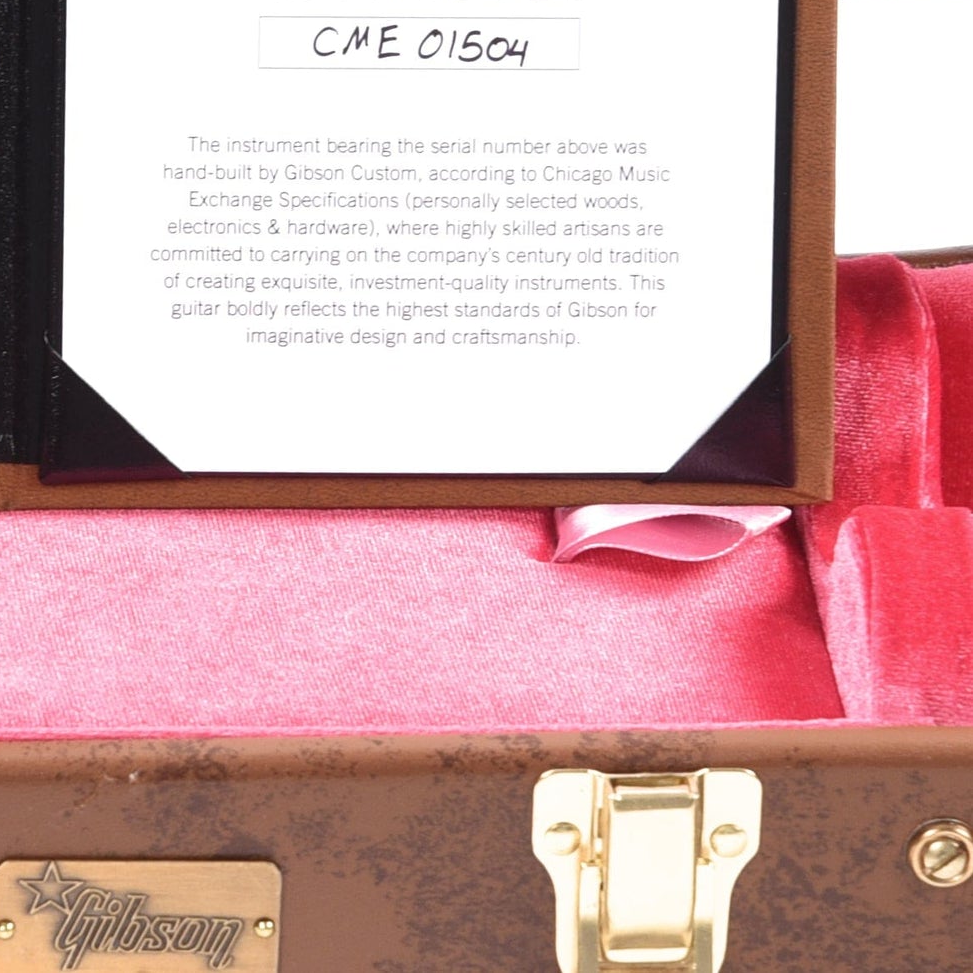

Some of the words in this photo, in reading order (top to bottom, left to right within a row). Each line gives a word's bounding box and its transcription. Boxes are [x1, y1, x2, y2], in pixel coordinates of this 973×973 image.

[313, 24, 401, 59] CME
[418, 29, 529, 67] 01504
[186, 135, 221, 153] The
[226, 136, 321, 154] instrument
[326, 137, 392, 158] bearing
[397, 138, 425, 154] the
[430, 138, 476, 155] serial
[482, 138, 552, 155] number
[556, 138, 609, 155] above
[613, 141, 648, 155] was
[163, 163, 252, 181] hand-built
[258, 164, 279, 185] by
[284, 163, 345, 181] Gibson
[350, 163, 423, 183] Custom,
[428, 165, 516, 186] according
[520, 166, 538, 182] to
[542, 165, 613, 186] Chicago
[618, 165, 671, 182] Music
[188, 190, 274, 212] Exchange
[278, 191, 400, 212] Specifications
[405, 191, 501, 213] (personally
[505, 192, 578, 210] selected
[583, 193, 644, 211] woods,
[167, 218, 262, 235] electronics
[267, 218, 281, 236] &
[287, 218, 380, 238] hardware),
[386, 219, 440, 236] where
[445, 219, 497, 240] highly
[502, 219, 557, 237] skilled
[562, 220, 631, 237] artisans
[635, 223, 664, 237] are
[150, 245, 243, 262] committed
[248, 246, 266, 263] to
[270, 246, 341, 267] carrying
[345, 250, 368, 263] on
[373, 246, 402, 263] the
[505, 247, 572, 268] century
[576, 247, 603, 264] old
[608, 247, 680, 264] tradition
[163, 272, 181, 289] of
[185, 273, 256, 294] creating
[260, 273, 343, 293] exquisite,
[349, 273, 510, 295] investment-quality
[514, 274, 623, 291] instruments.
[628, 274, 666, 291] This
[170, 299, 222, 320] guitar
[227, 300, 279, 321] boldly
[284, 300, 347, 317] reflects
[352, 300, 380, 318] the
[386, 301, 449, 322] highest
[454, 301, 541, 318] standards
[545, 301, 563, 318] of
[567, 301, 628, 319] Gibson
[634, 301, 658, 318] for
[246, 327, 345, 348] imaginative
[349, 328, 407, 349] design
[412, 328, 446, 345] and
[451, 328, 580, 348] craftsmanship.
[53, 885, 244, 972] Gibson
